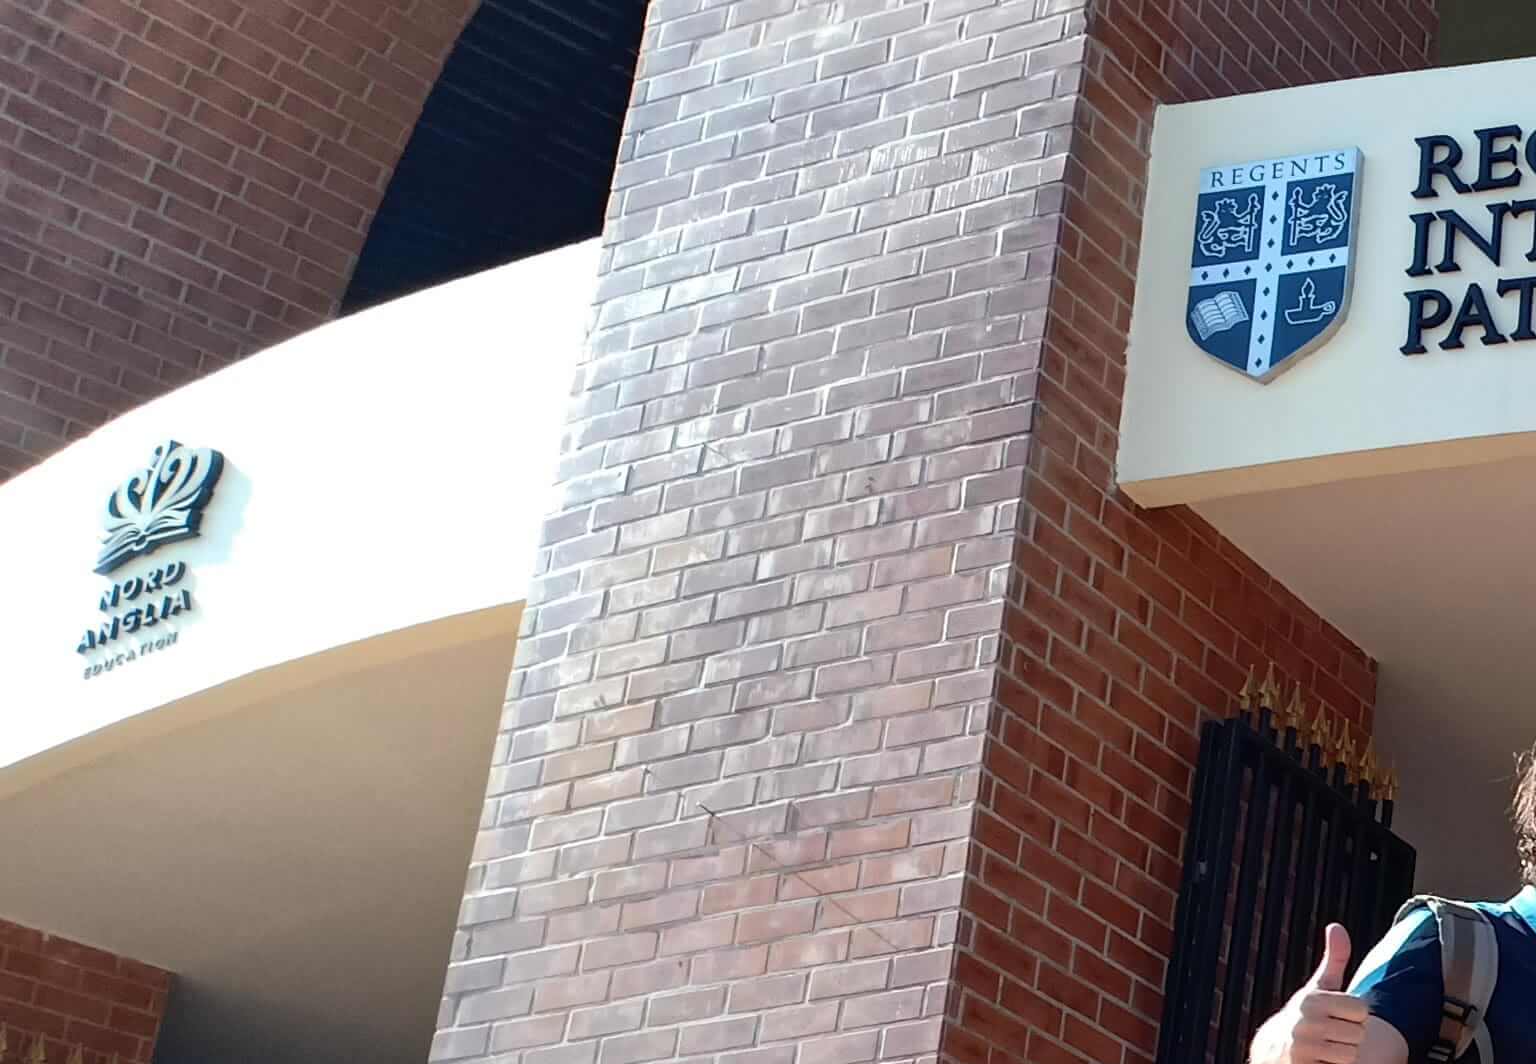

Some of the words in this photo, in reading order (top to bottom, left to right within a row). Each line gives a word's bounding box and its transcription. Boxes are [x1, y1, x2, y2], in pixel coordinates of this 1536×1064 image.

[1209, 152, 1346, 188] REGENTS
[99, 560, 187, 612] NORD
[75, 588, 193, 655] ANGLIA
